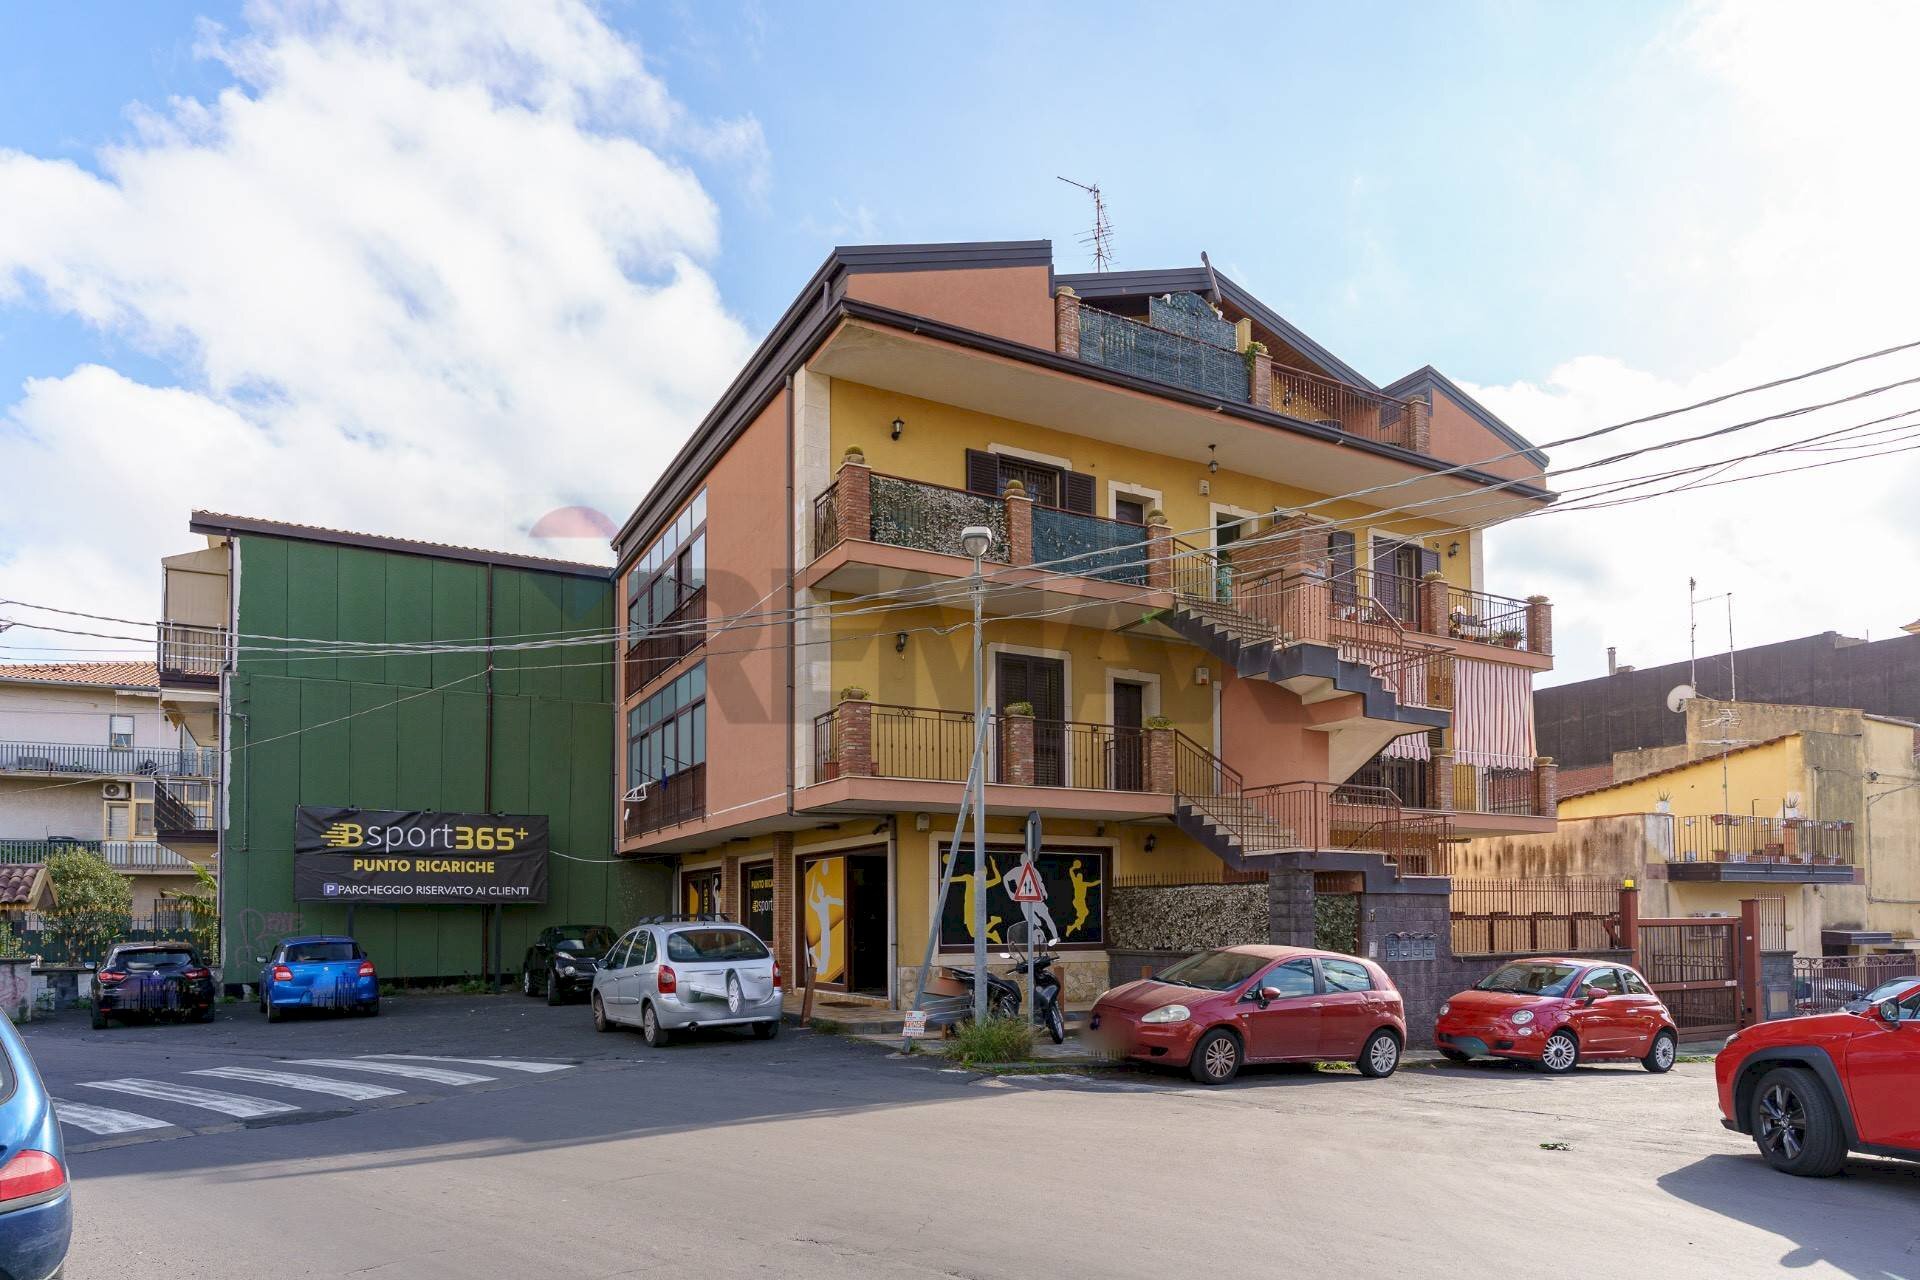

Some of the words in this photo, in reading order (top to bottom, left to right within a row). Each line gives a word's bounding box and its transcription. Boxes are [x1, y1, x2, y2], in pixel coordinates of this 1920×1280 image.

[353, 859, 411, 872] PUNTO
[415, 860, 495, 874] RICARICHE
[338, 885, 413, 895] PARCHEGGIO
[416, 886, 473, 895] RISERVATO
[475, 886, 486, 895] AI
[489, 887, 529, 896] CLIENTI
